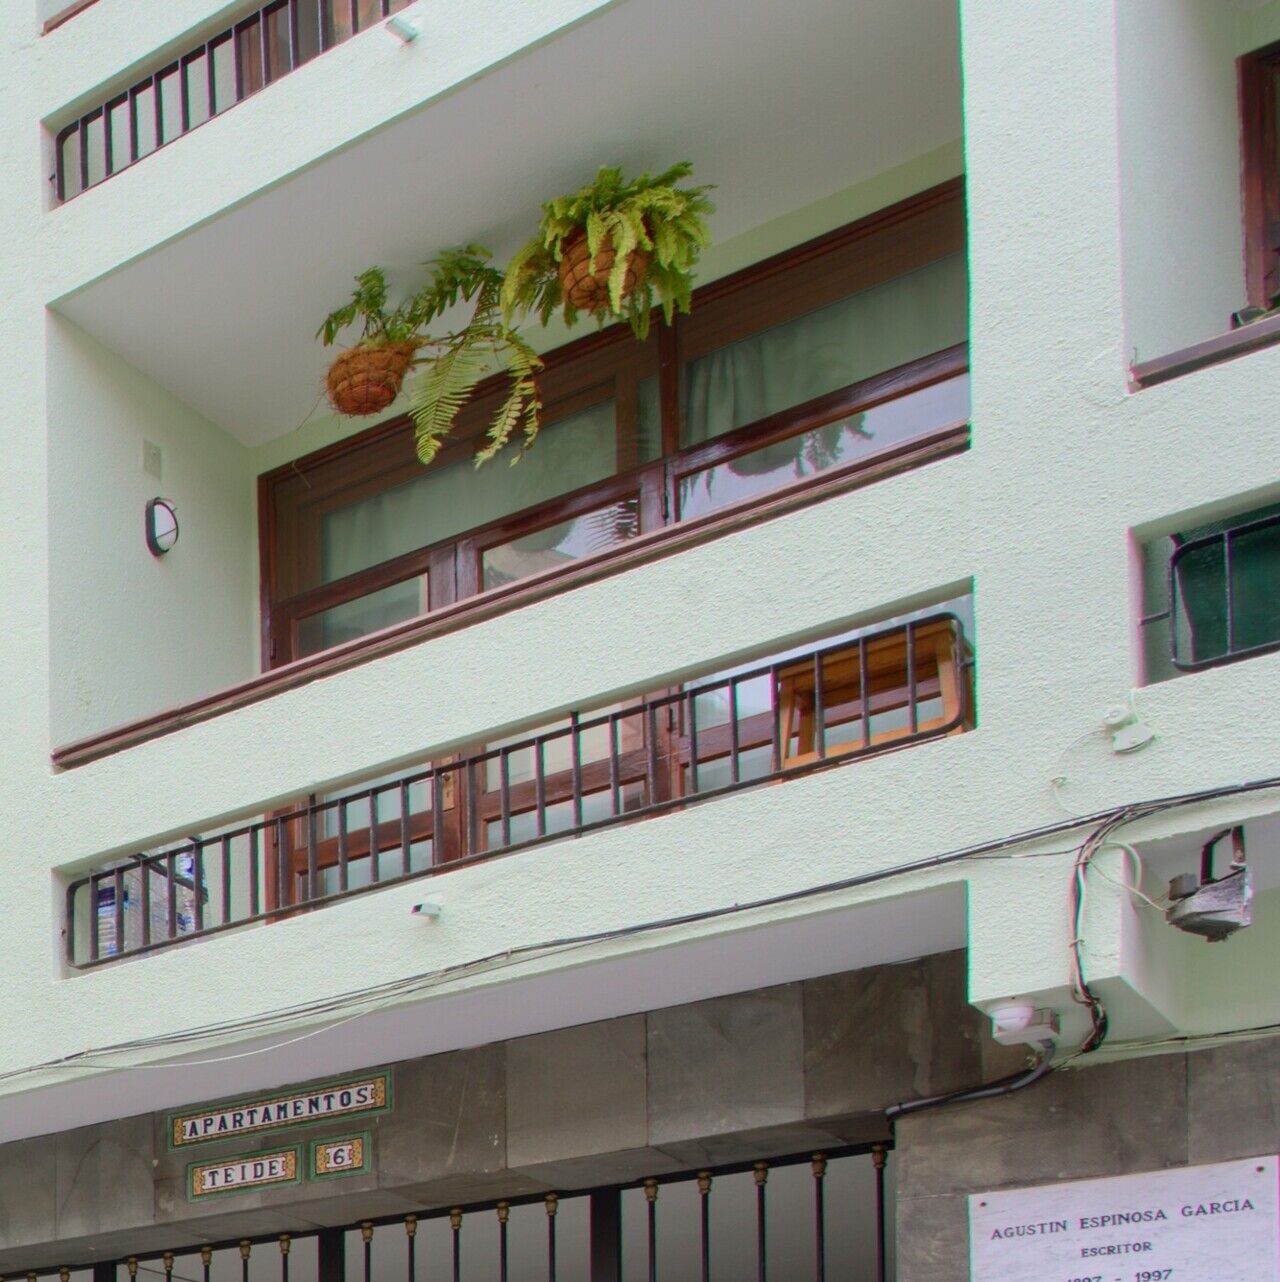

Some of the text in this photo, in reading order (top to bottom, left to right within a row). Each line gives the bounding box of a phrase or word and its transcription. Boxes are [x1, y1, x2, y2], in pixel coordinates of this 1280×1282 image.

[188, 1086, 369, 1137] APARTAMENTOS
[208, 1148, 345, 1187] TEIDE 6
[990, 1198, 1256, 1241] AGUSTIN ESPINOSA GARCIA
[1080, 1240, 1153, 1259] ESCRITOR
